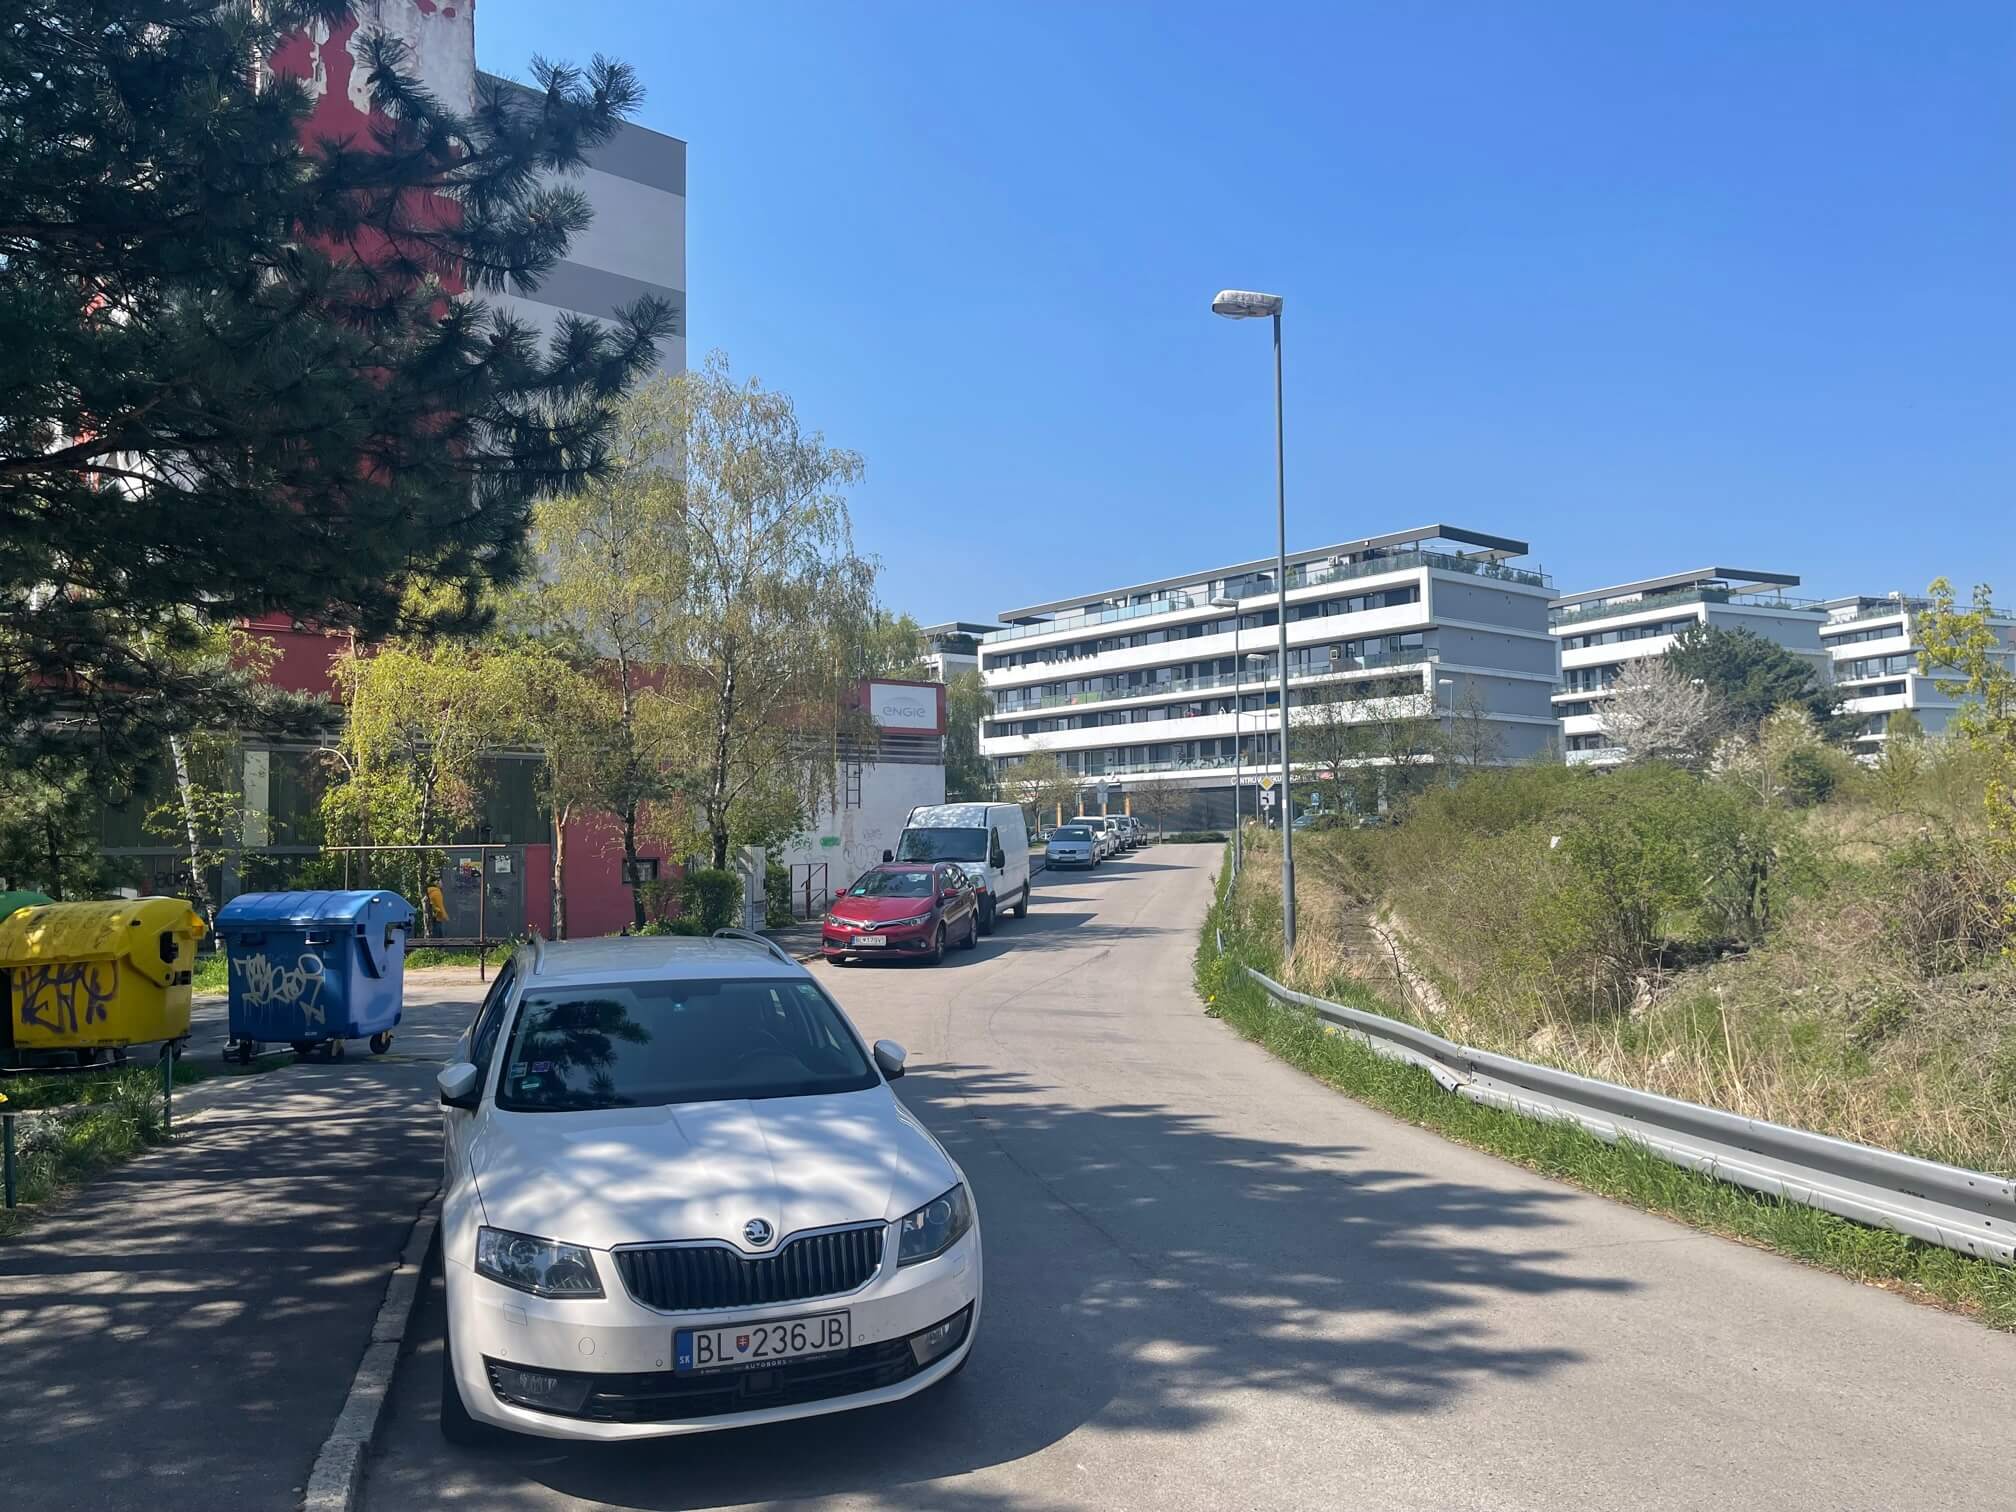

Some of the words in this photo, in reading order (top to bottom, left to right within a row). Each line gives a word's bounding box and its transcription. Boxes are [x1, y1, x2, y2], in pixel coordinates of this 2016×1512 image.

[697, 1333, 734, 1364] BL
[752, 1318, 844, 1358] 236JB
[679, 1354, 691, 1364] SK
